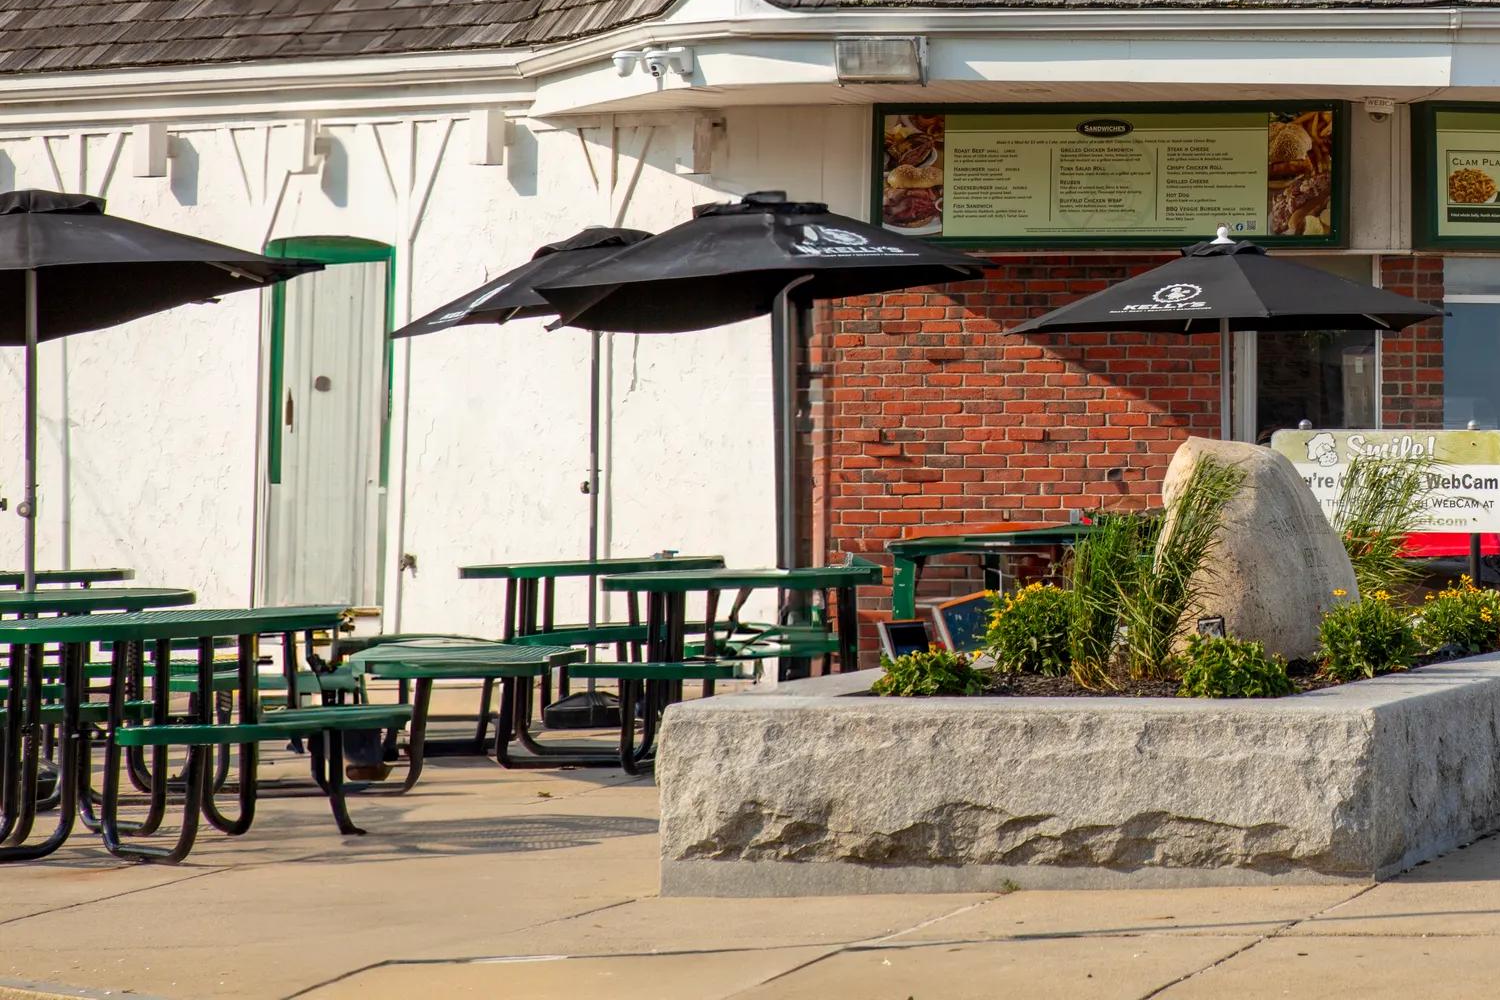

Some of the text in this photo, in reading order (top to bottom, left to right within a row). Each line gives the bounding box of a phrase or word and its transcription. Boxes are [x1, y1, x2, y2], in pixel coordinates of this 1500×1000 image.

[1452, 158, 1478, 166] CLAM
[1346, 434, 1435, 460] Smile!
[1426, 474, 1498, 489] WebCam
